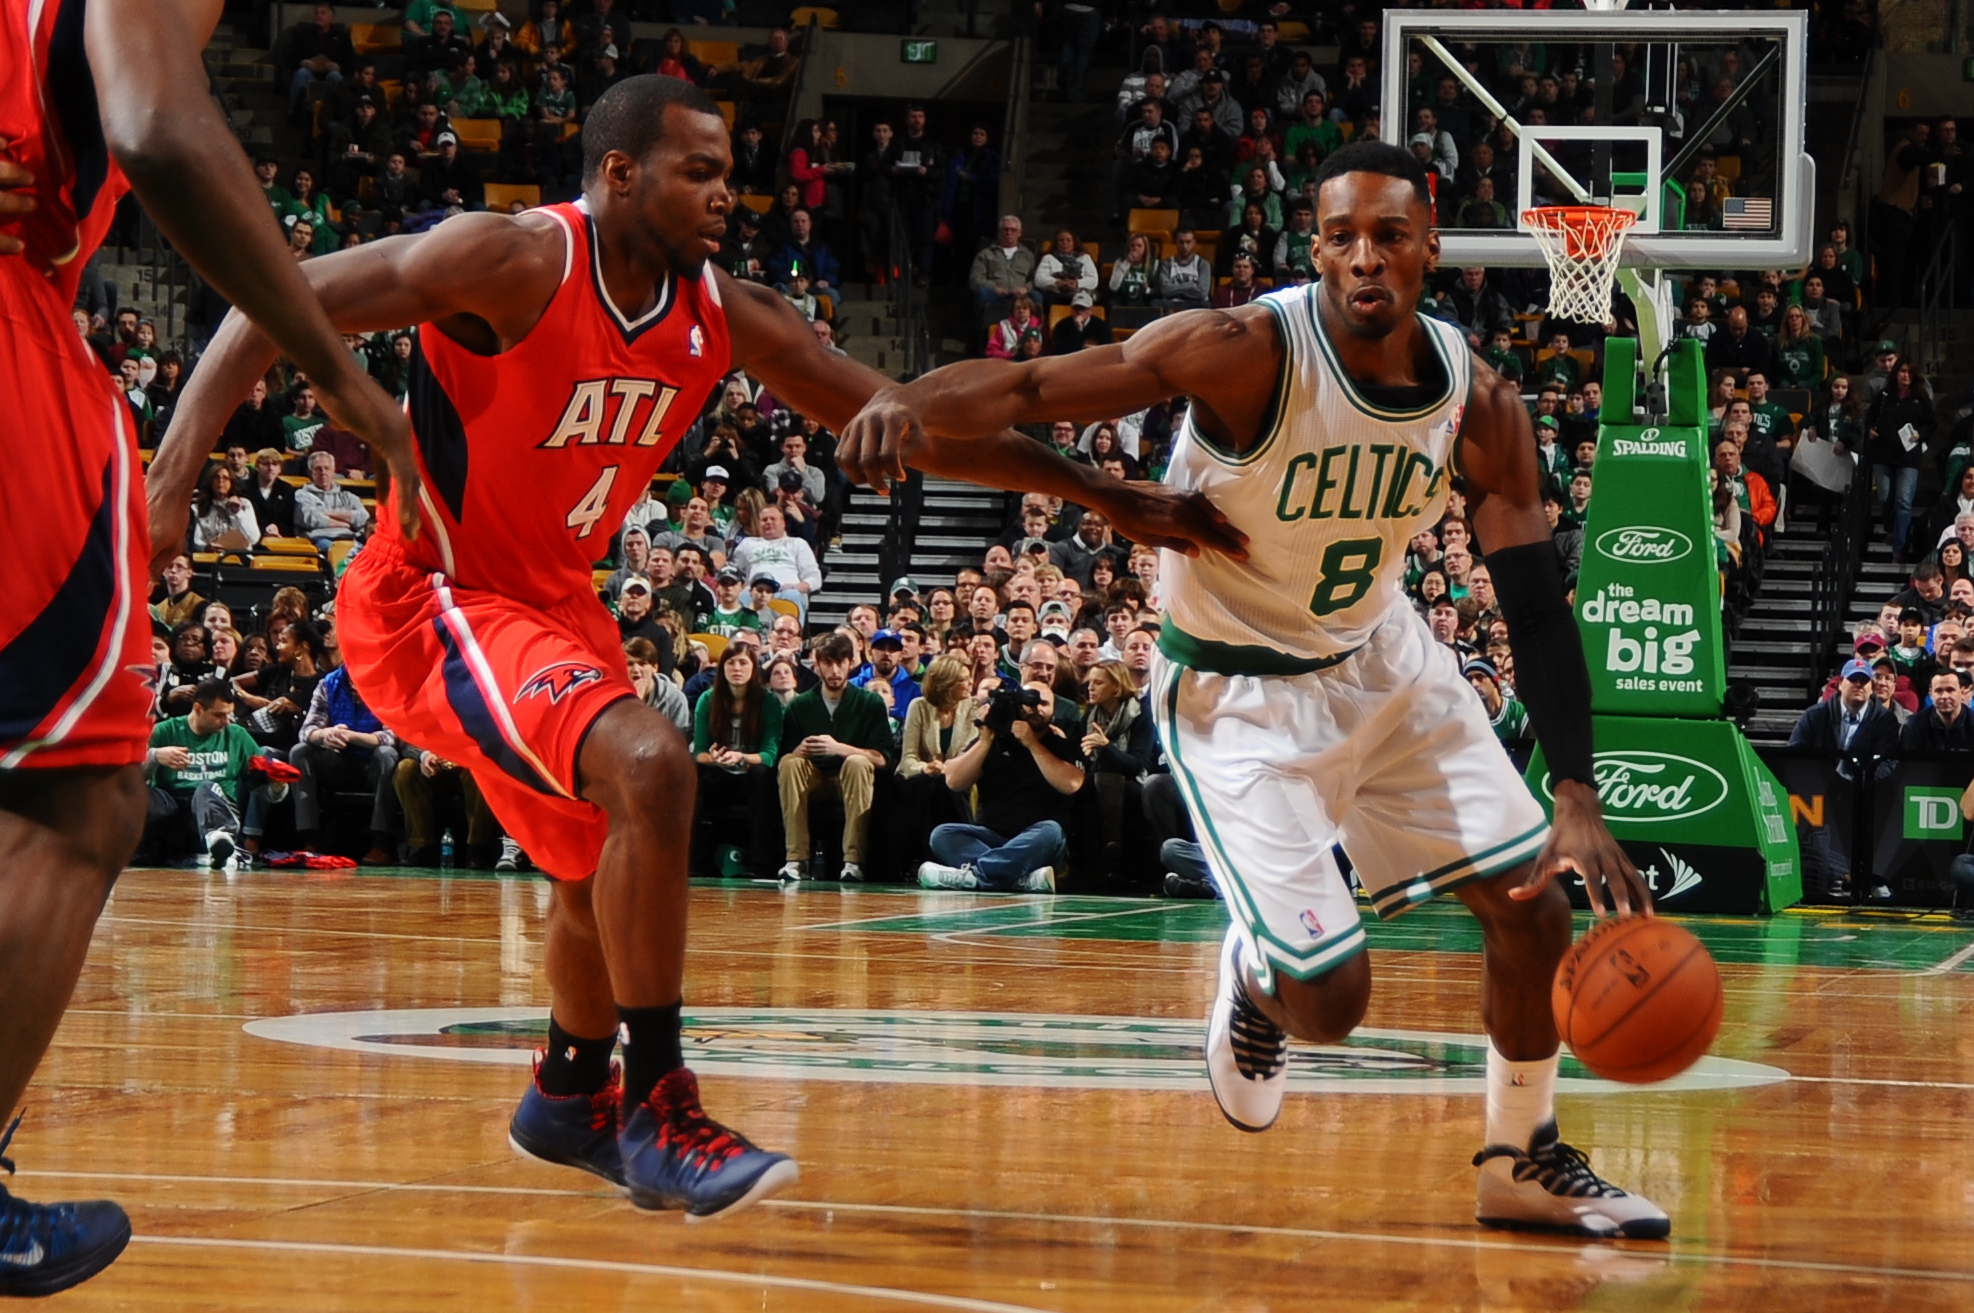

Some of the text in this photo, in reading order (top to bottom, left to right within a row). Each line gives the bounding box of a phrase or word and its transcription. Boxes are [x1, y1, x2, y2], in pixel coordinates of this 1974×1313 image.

[535, 376, 682, 449] ATL
[1613, 439, 1687, 457] SPALDING
[566, 464, 619, 540] 4
[1612, 530, 1676, 558] Ford
[1310, 537, 1383, 616] 8
[1608, 582, 1634, 597] the
[1582, 589, 1693, 626] dream
[1606, 626, 1701, 675] big
[1616, 677, 1703, 692] sales event
[185, 751, 228, 766] OSTON
[1593, 759, 1695, 810] Ford
[1909, 795, 1958, 829] TD
